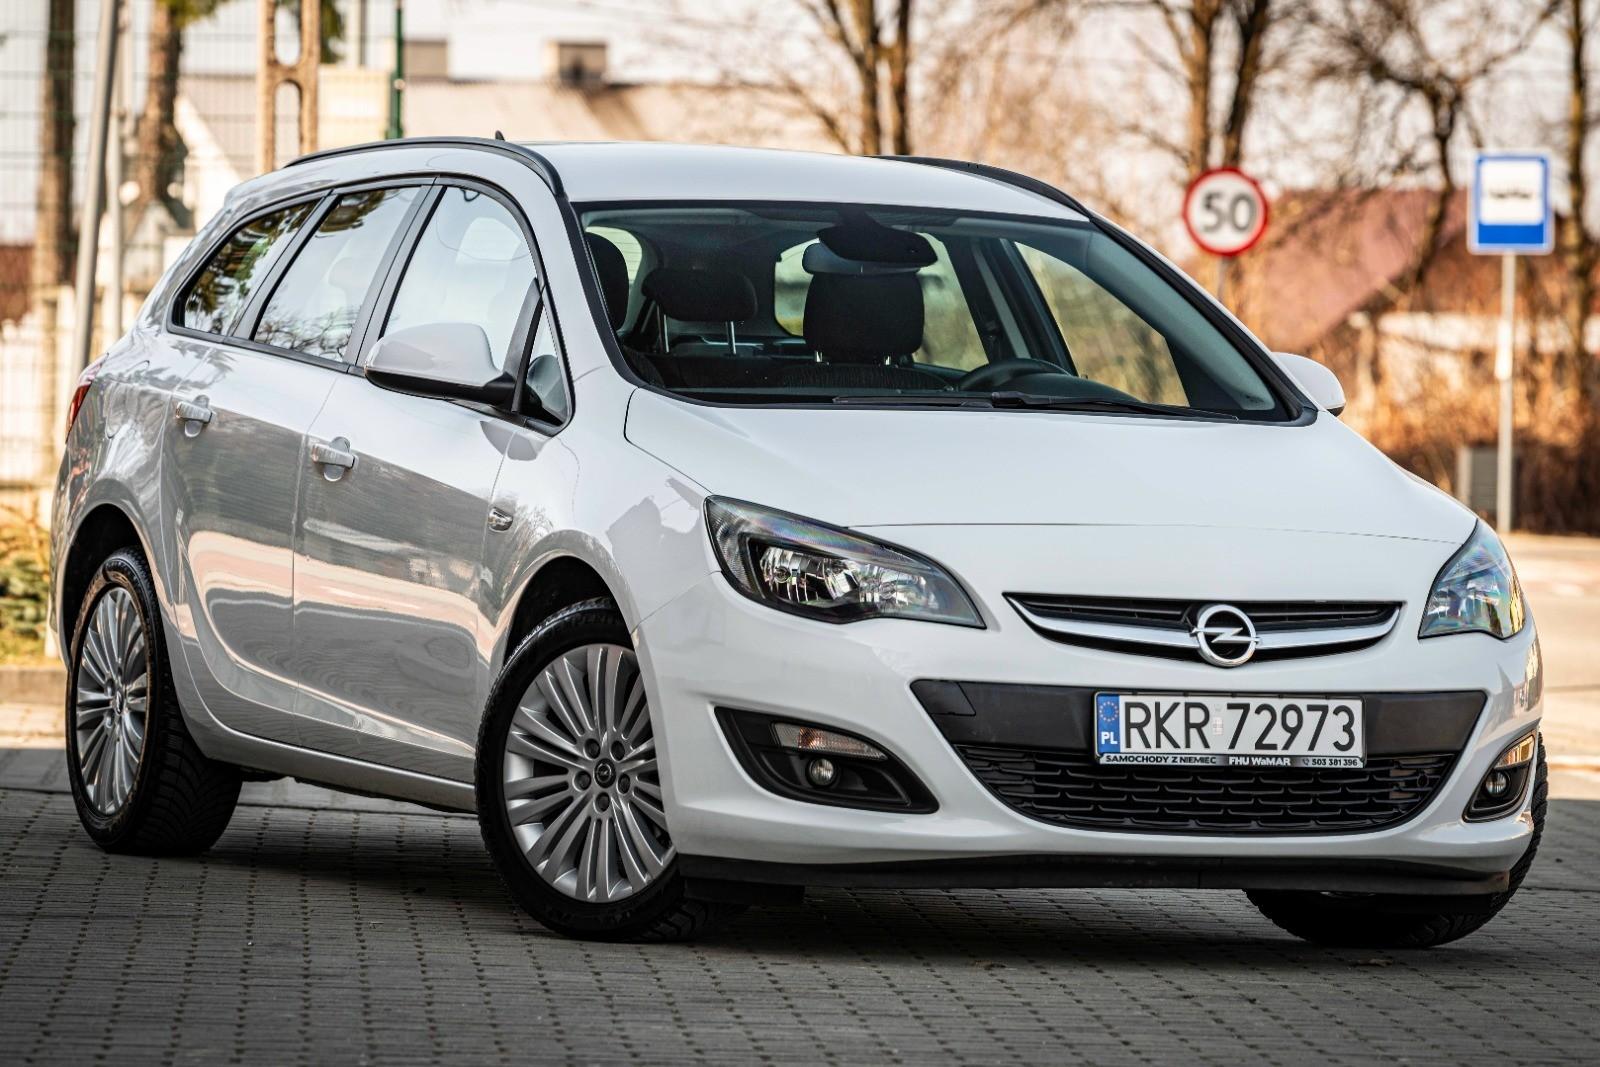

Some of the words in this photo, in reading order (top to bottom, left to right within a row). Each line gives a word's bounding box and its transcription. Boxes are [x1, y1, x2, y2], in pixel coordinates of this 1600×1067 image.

[1203, 191, 1256, 232] 50
[1101, 731, 1118, 745] PL
[1124, 701, 1210, 750] RKR
[1226, 703, 1355, 751] 72973
[1105, 754, 1169, 764] SAMOCHODY
[1171, 755, 1178, 764] Z
[1179, 755, 1217, 765] NIEMIEC
[1228, 757, 1250, 766] FHU
[1251, 757, 1291, 767] WaMAR
[1311, 758, 1327, 767] 503
[1328, 758, 1341, 767] 381
[1343, 758, 1358, 767] 396
